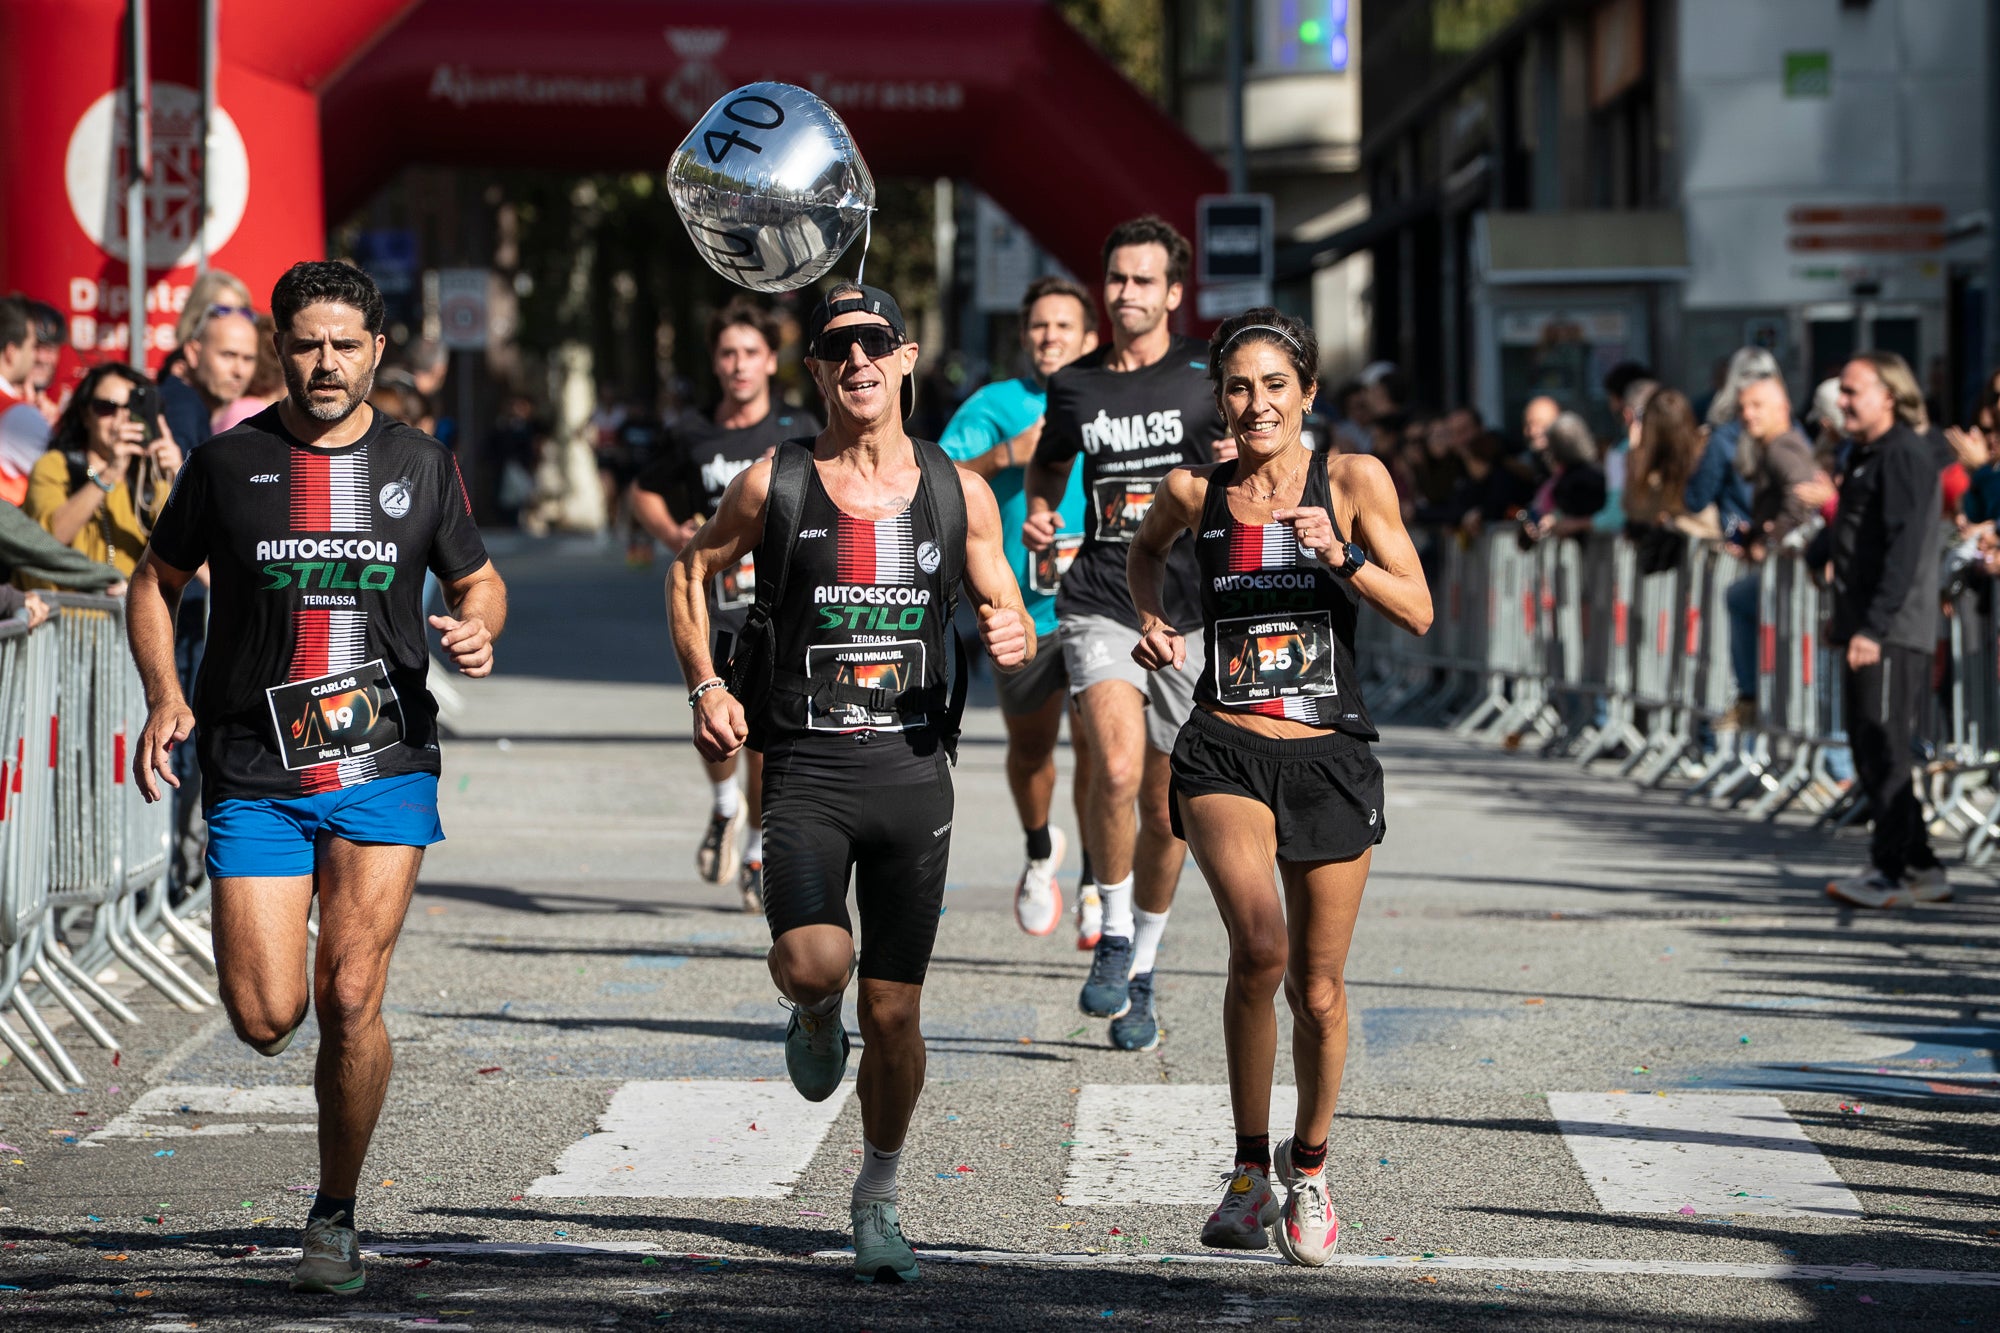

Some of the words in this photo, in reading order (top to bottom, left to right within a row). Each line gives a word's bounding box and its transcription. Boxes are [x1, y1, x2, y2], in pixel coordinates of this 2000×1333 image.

[250, 473, 280, 483] 42K
[799, 528, 828, 539] 42K
[1203, 529, 1226, 539] 42K
[256, 538, 397, 562] AUTOESCOLA
[261, 562, 396, 592] STILO
[1213, 574, 1316, 592] AUTOESCOLA
[303, 595, 356, 606] TERRASSA
[814, 585, 930, 605] AUTOESCOLA
[816, 605, 925, 631] STILO
[1248, 621, 1299, 635] CRISTINA
[852, 634, 897, 644] TERRASSA
[836, 653, 862, 662] JUAN
[863, 650, 904, 662] MNAUEL
[1258, 647, 1292, 671] 25
[310, 676, 357, 696] CARLOS
[325, 706, 354, 731] 19
